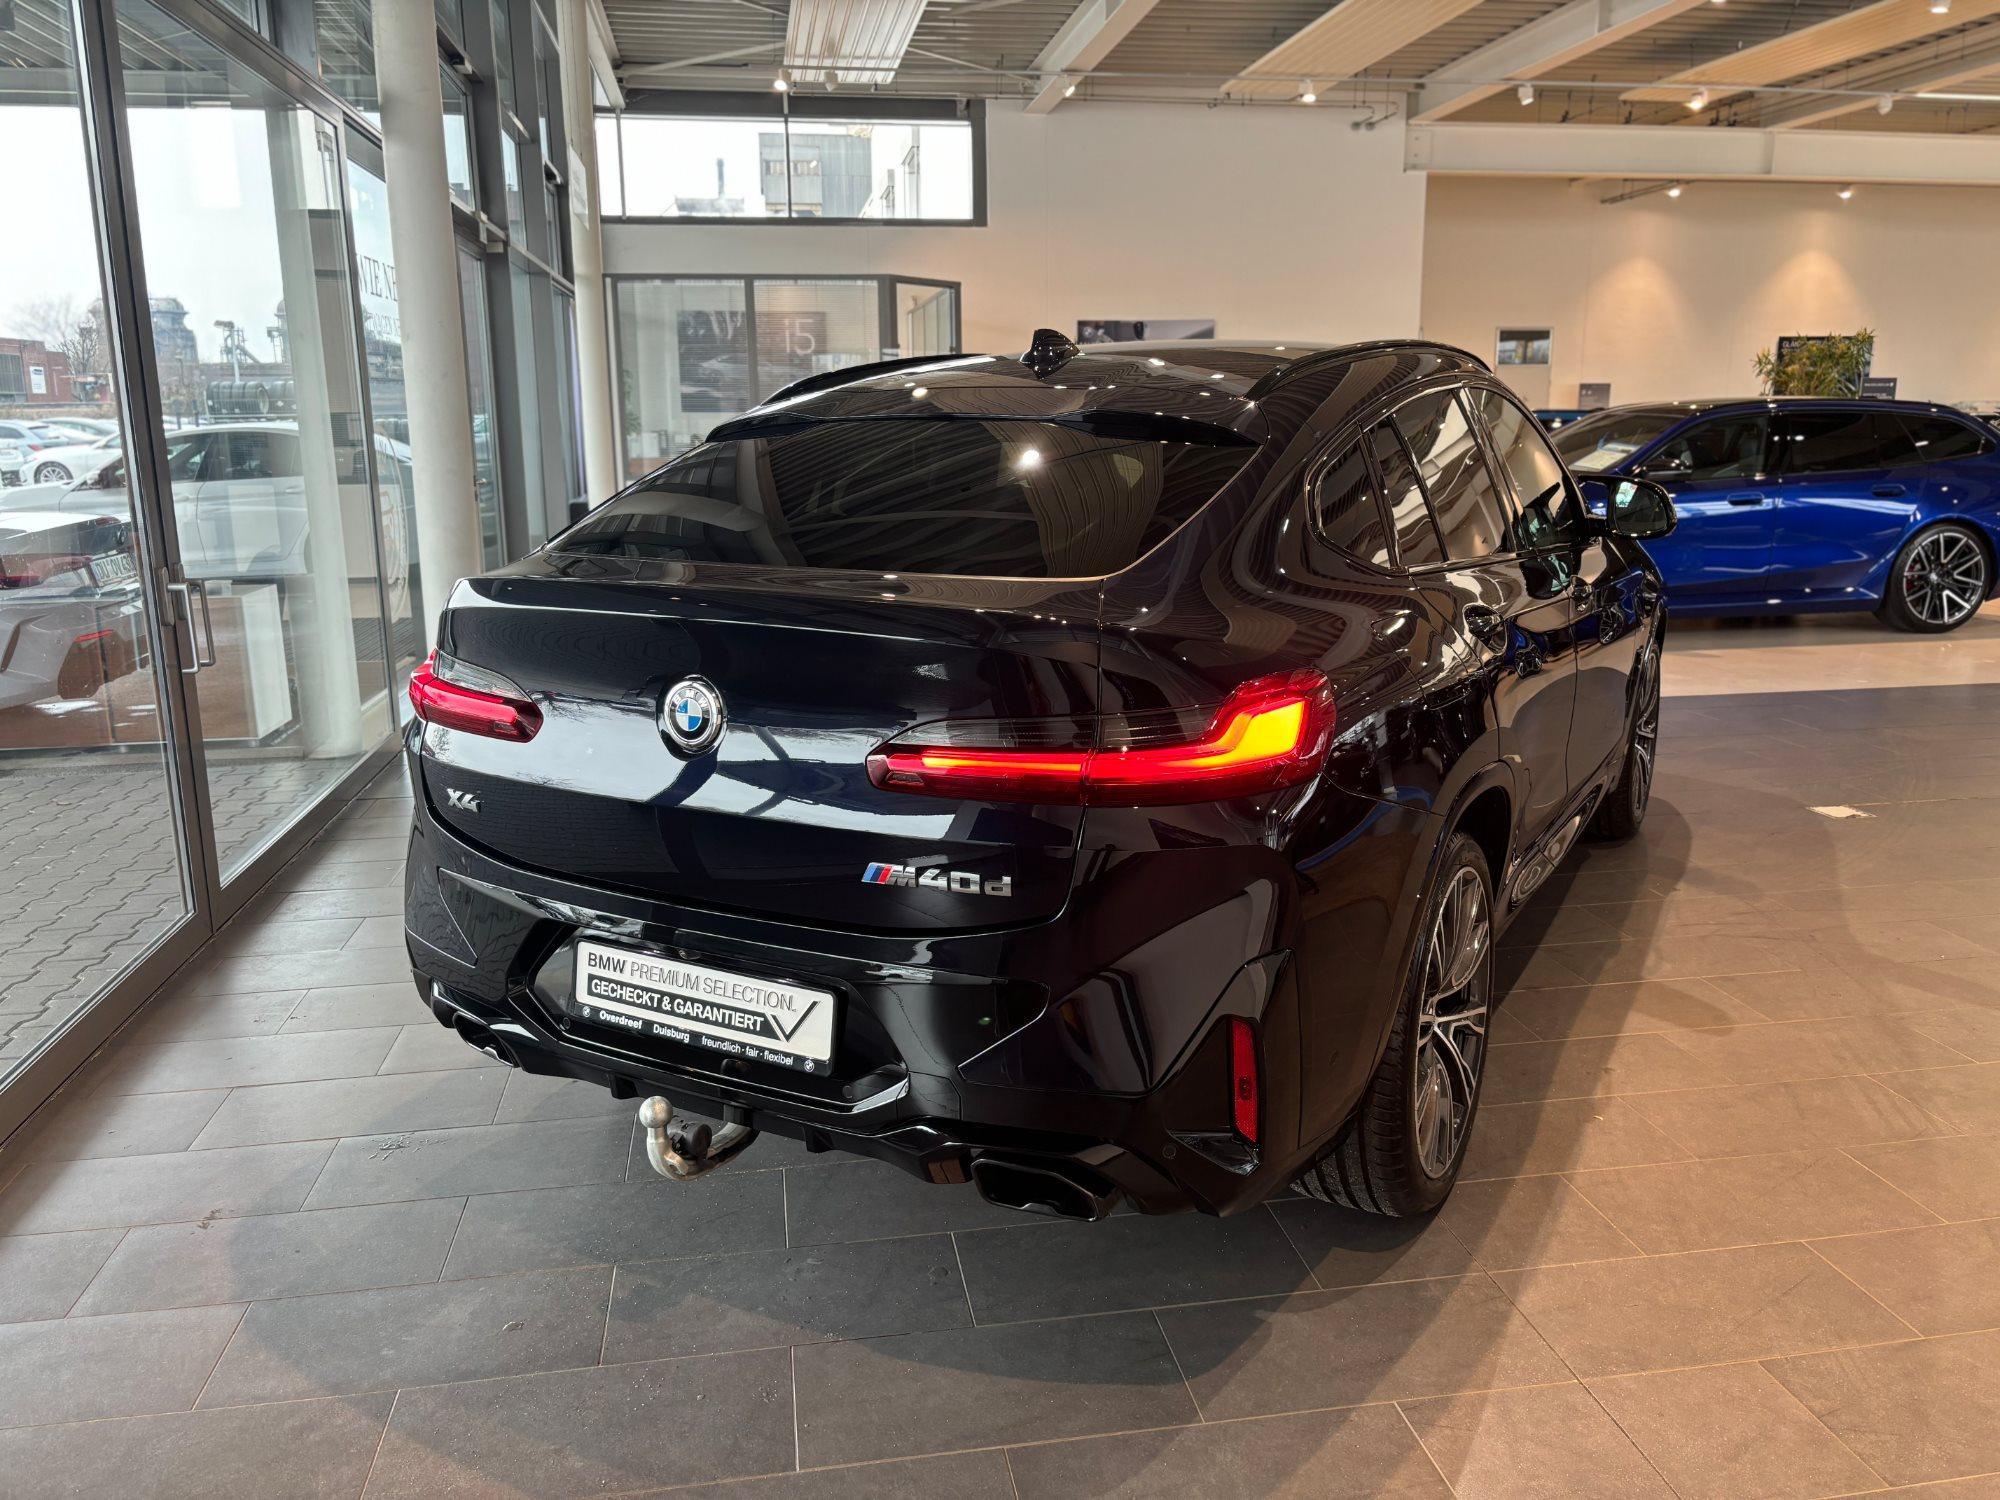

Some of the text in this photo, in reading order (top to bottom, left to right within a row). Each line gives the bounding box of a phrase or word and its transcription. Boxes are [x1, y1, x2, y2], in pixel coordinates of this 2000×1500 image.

[447, 788, 480, 813] X4
[885, 863, 1012, 897] M40d
[588, 951, 626, 974] BMW
[630, 961, 700, 992] PREMIUM
[591, 979, 765, 1032] GECHECKT & GARANTIERT
[600, 1010, 794, 1066] Overdreef Duisburg freundlich fair flexibel
